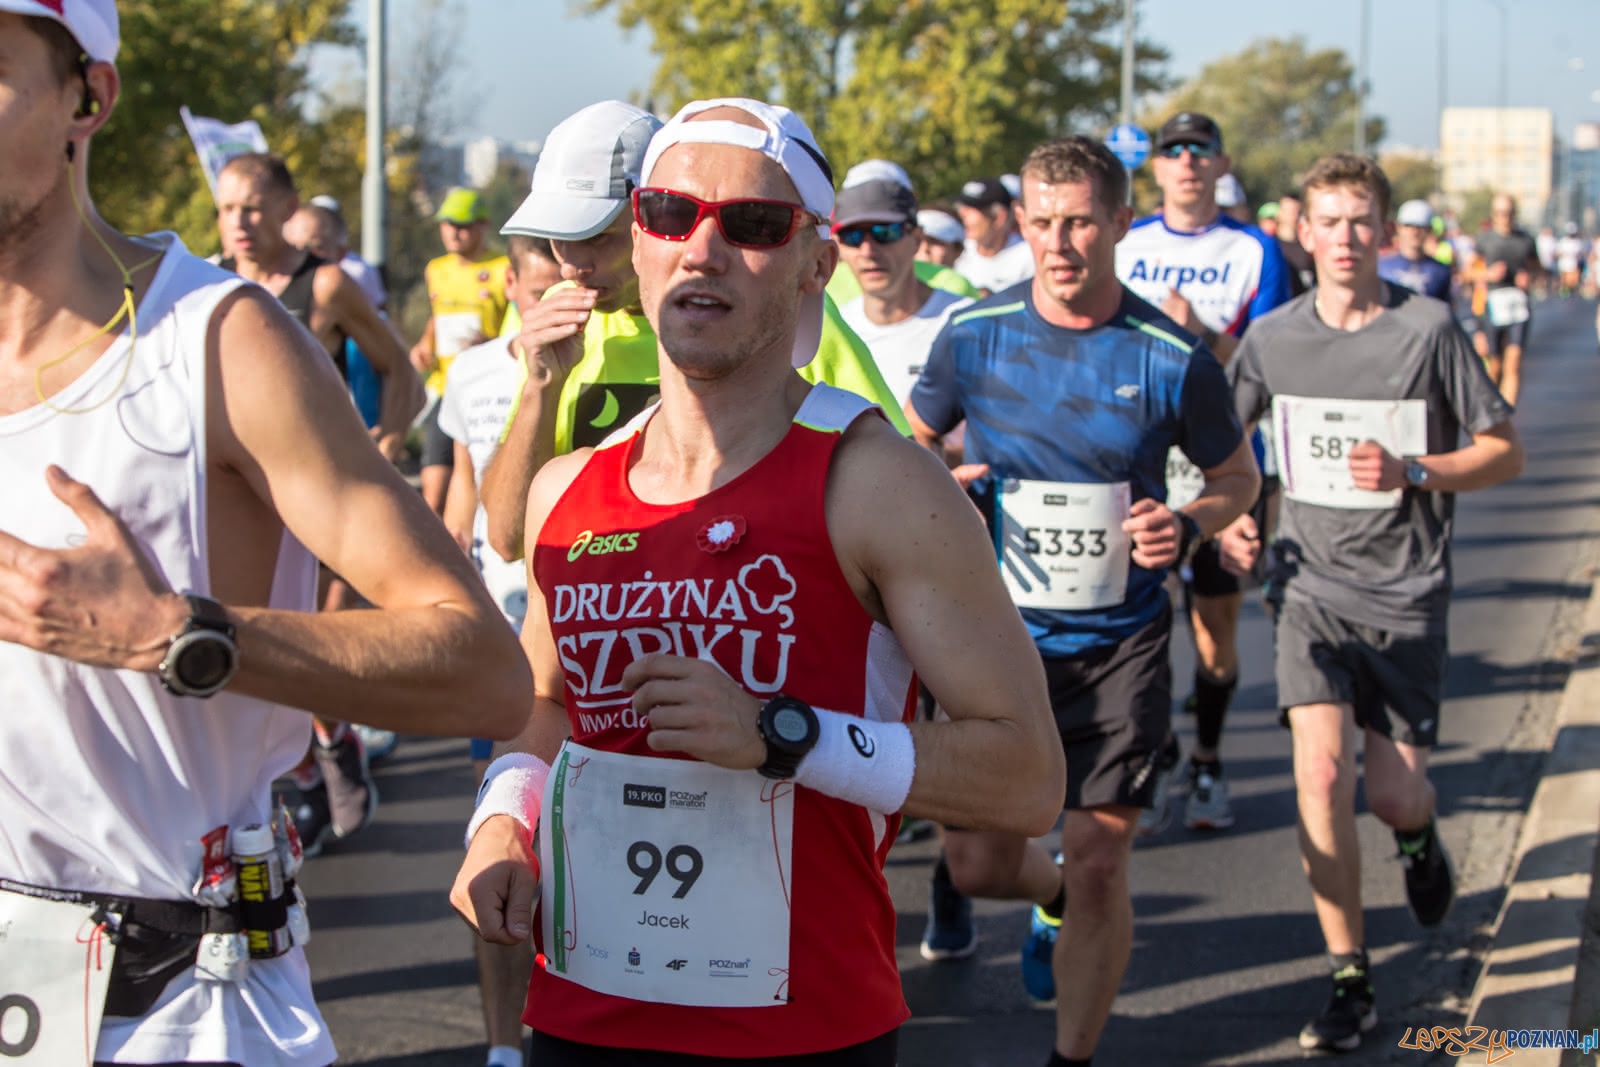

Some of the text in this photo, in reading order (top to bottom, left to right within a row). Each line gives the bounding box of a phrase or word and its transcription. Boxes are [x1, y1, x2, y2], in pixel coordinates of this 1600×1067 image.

[1129, 259, 1231, 292] Airpol
[586, 531, 640, 556] asics
[1024, 528, 1106, 557] 5333
[553, 570, 748, 623] DRUŻYNA
[641, 791, 662, 802] PKO
[626, 841, 704, 899] 99
[637, 910, 690, 930] Jacek
